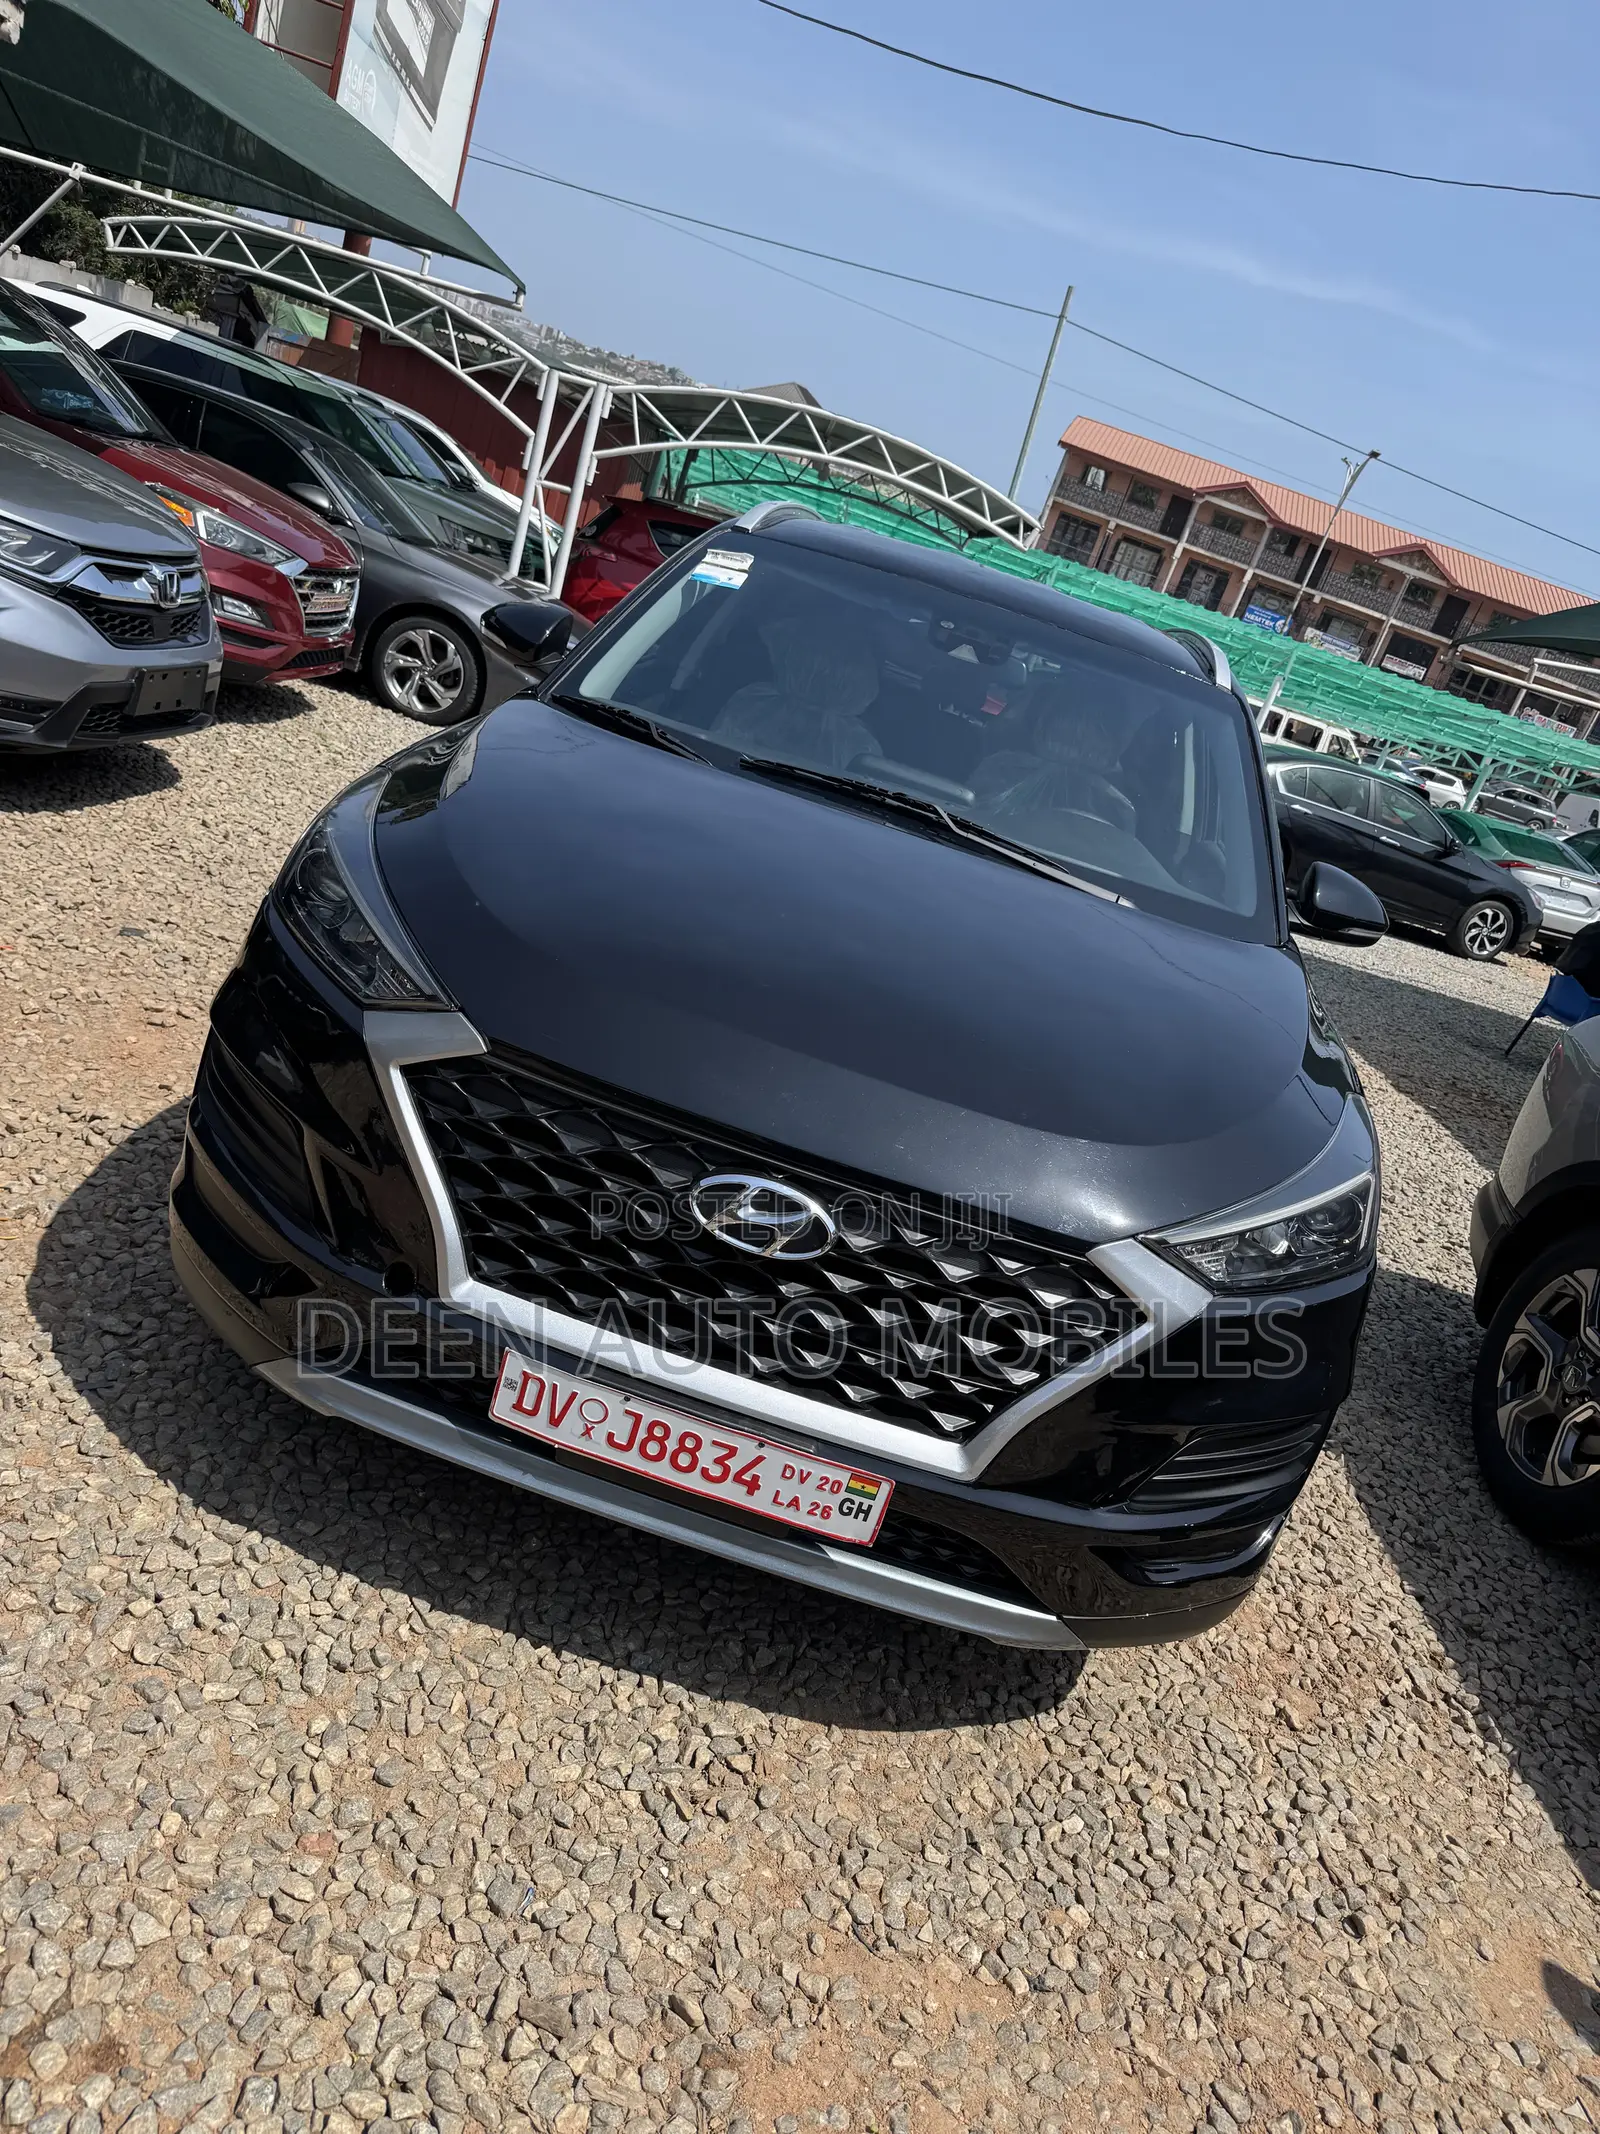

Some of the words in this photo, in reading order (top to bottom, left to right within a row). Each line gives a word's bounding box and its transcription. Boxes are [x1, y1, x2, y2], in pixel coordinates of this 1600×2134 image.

[344, 59, 364, 96] AGM
[1244, 612, 1275, 628] NEMTEK
[511, 1368, 580, 1428] DV
[606, 1407, 767, 1497] J8834
[780, 1463, 813, 1485] DV
[816, 1475, 844, 1495] 20
[771, 1489, 801, 1512] LA
[806, 1501, 833, 1520] 26
[838, 1497, 873, 1523] GH
